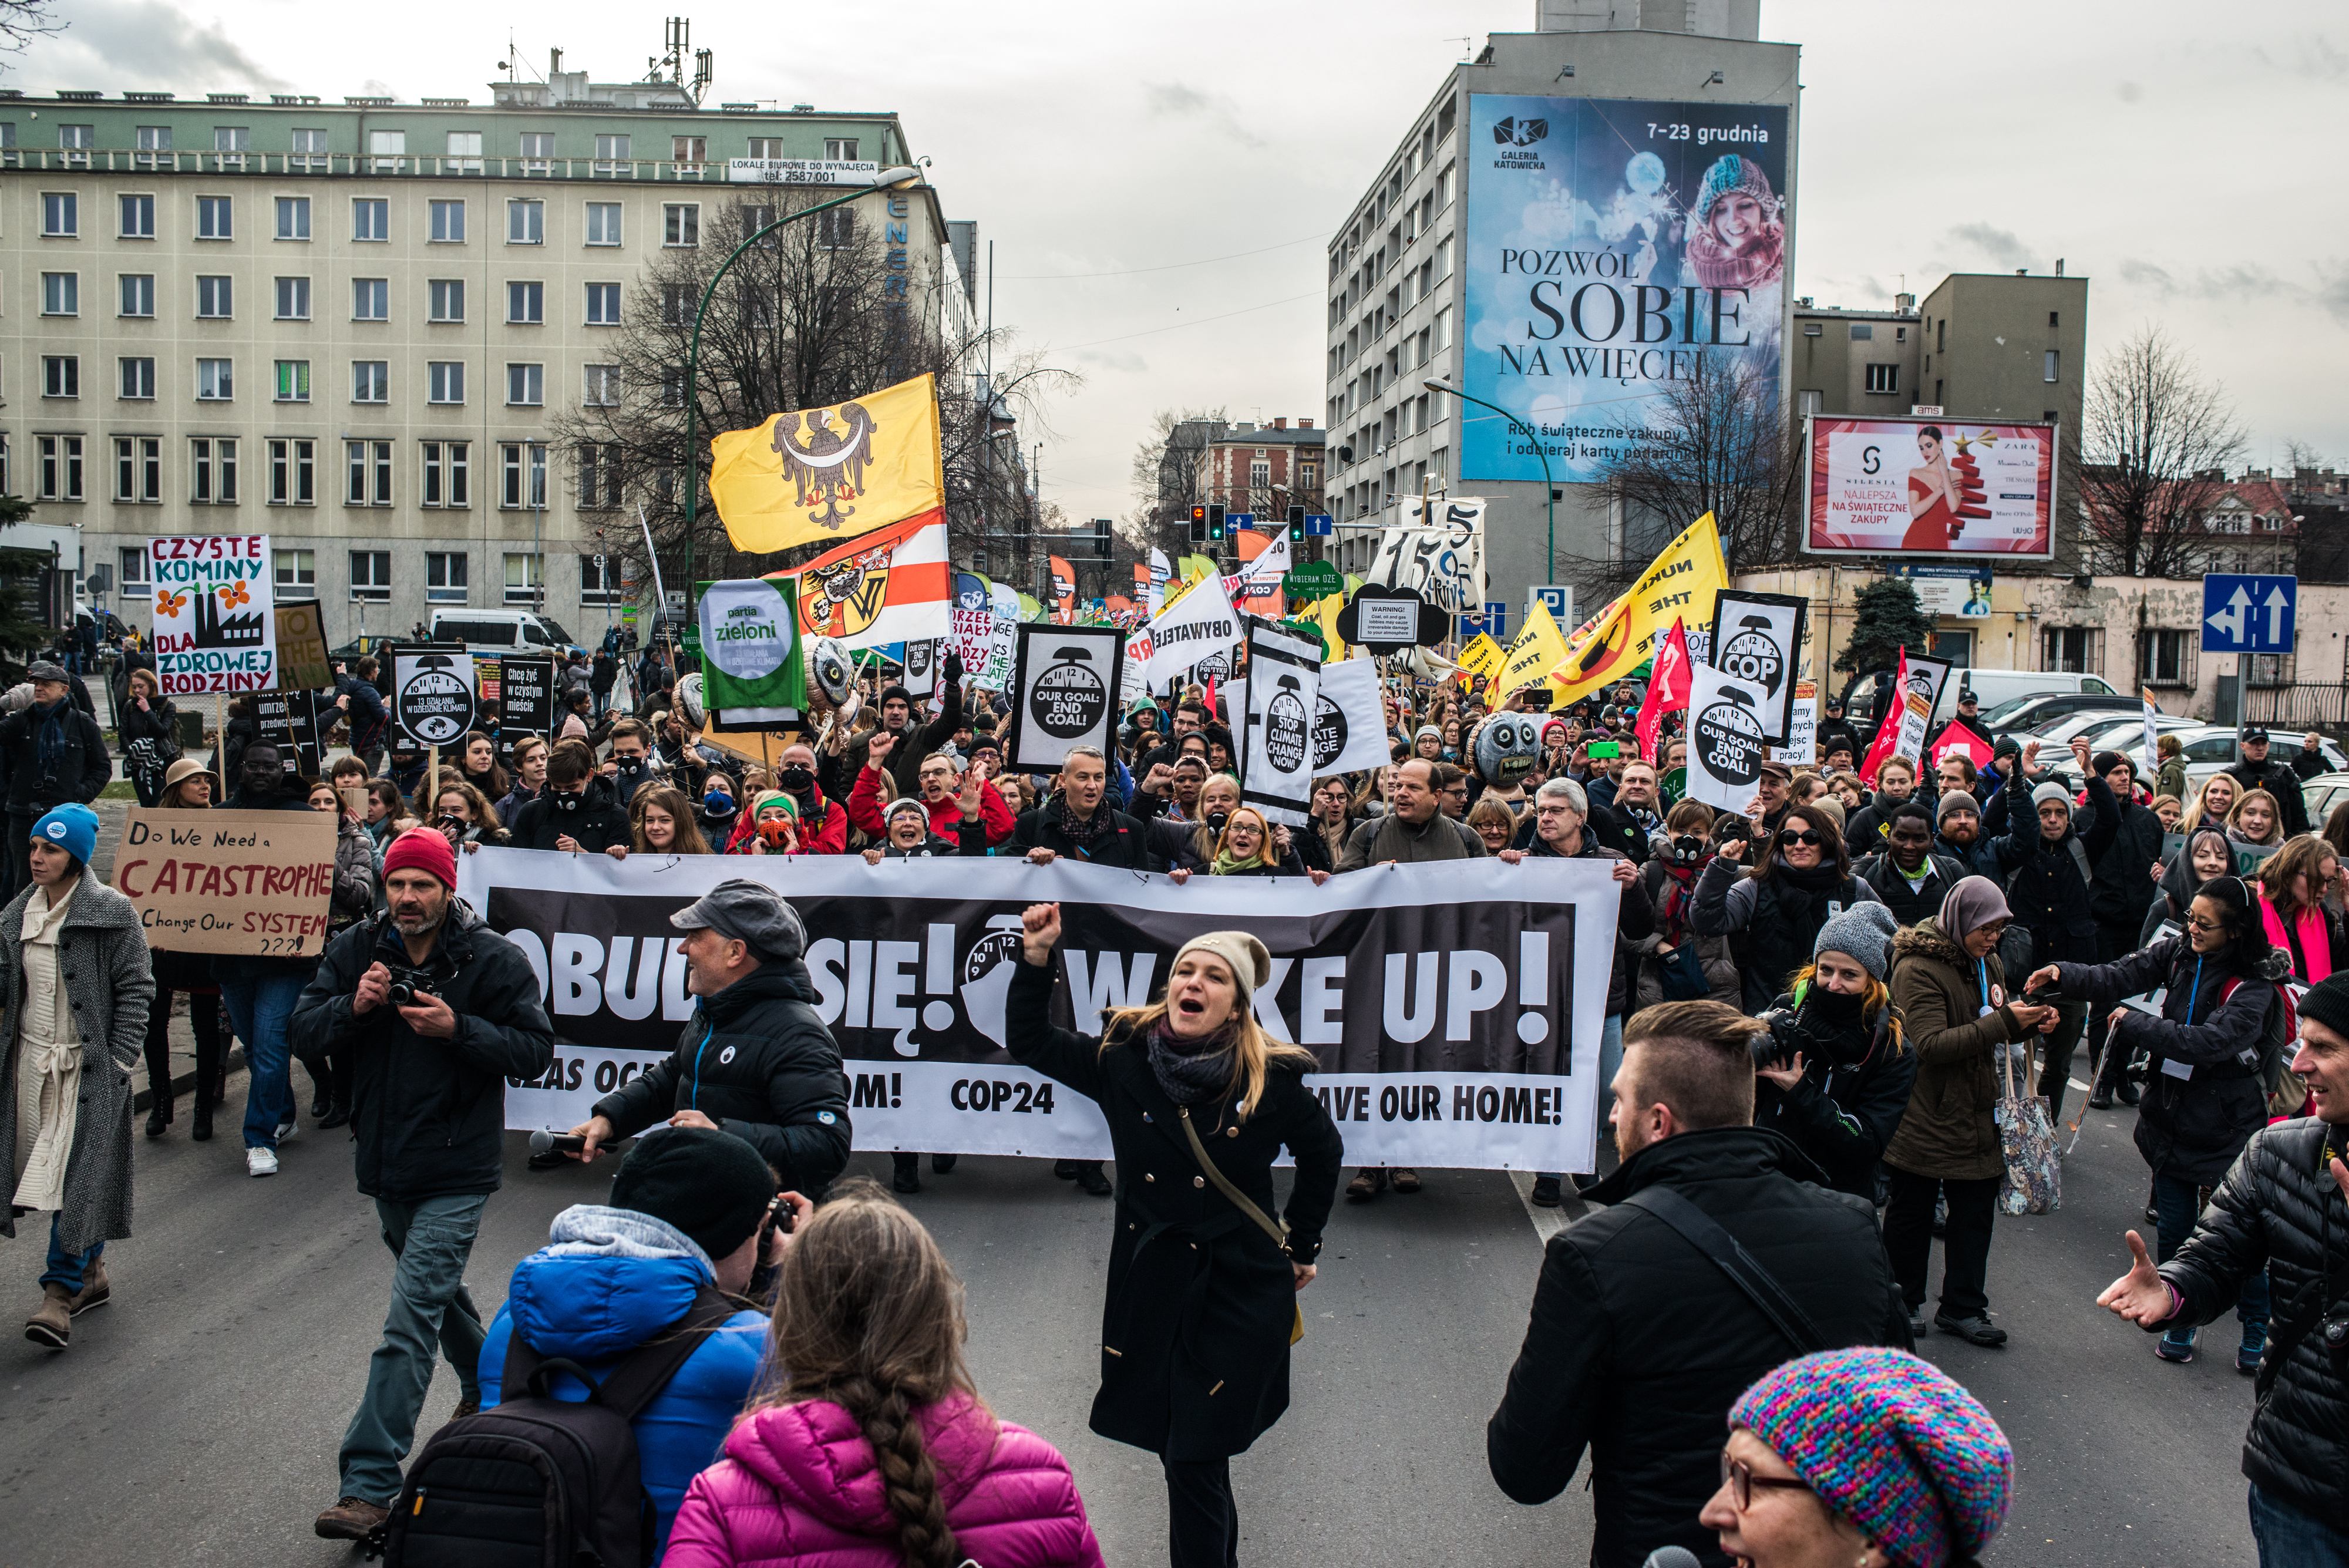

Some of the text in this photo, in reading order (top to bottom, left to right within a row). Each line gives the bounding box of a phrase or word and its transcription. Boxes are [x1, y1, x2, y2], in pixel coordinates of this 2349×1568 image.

[1647, 123, 1768, 144] 7-23 grudnia
[1501, 151, 1539, 160] GALERIA
[732, 161, 764, 169] LOKALE
[768, 161, 806, 170] BIUROWE
[824, 162, 875, 172] WYNAJĘCIA
[1493, 160, 1546, 170] KATOWICKA
[1500, 245, 1639, 278] POZWÓL
[1527, 280, 1751, 346] SOBIE
[1497, 344, 1701, 387] NA WIĘCEJ
[1917, 406, 1940, 415] ams
[1508, 422, 1681, 443] Rób świąteczne zakupy
[1506, 441, 1618, 460] i odbieraj karty
[1844, 490, 1897, 500] NAJLEPSZA
[1832, 500, 1908, 514] NA ŚWIĄTECZNE
[1850, 514, 1890, 525] ZAKUPY
[153, 536, 261, 560] CZYSTE
[155, 559, 263, 583] KOMINY
[1290, 574, 1336, 583] WYBIERAM OZE
[1544, 592, 1559, 607] P
[728, 606, 757, 618] partia
[277, 610, 310, 637] TO
[715, 620, 776, 641] zieloni
[157, 632, 198, 654] DLA
[961, 637, 974, 646] W
[278, 638, 322, 665] THE
[914, 651, 923, 659] END
[158, 650, 272, 674] ZDROWEJ
[911, 658, 925, 668] COAL!
[1725, 654, 1777, 678] COP
[432, 675, 440, 684] 12
[508, 668, 537, 684] Chcę żyć
[1055, 671, 1062, 679] 11
[1067, 668, 1076, 677] 12
[161, 671, 272, 694] RODZINY
[1044, 677, 1053, 685] 10
[1089, 678, 1095, 687] 2
[508, 685, 543, 698] w czystym
[1036, 691, 1099, 703] OUR GOAL:
[427, 696, 455, 705] DZIAŁANIA
[507, 699, 534, 712] mieście
[1279, 700, 1283, 708] 11
[1286, 698, 1291, 706] 12
[413, 705, 442, 713] DZIEDZINIE
[443, 704, 467, 712] KLIMATU
[1053, 702, 1082, 714] END
[1273, 705, 1278, 714] 10
[1718, 709, 1725, 718] 11
[1731, 710, 1739, 720] 12
[1045, 713, 1086, 726] COAL!
[1278, 716, 1298, 731] STOP
[1709, 712, 1717, 721] 10
[1908, 715, 1924, 733] Czujesz
[1270, 728, 1302, 747] CLIMATE
[1701, 724, 1761, 755] OUR GOAL:
[1905, 730, 1920, 747] klimat?
[1267, 744, 1303, 761] CHANGE
[1716, 741, 1745, 760] END
[1779, 749, 1805, 762] pracy!
[1902, 745, 1913, 761] Walcz
[1273, 755, 1295, 769] NOW!
[1708, 751, 1749, 776] COAL!
[129, 822, 270, 847] Do We Need a
[120, 859, 334, 898] CATASTROPHE
[142, 909, 328, 937] Change Our SYSTEM
[984, 943, 992, 952] 11
[1002, 937, 1015, 947] 12
[973, 953, 986, 963] 10
[971, 966, 980, 976] 9
[804, 923, 954, 1056] SIĘ!
[1384, 931, 1549, 1045] UP!
[950, 1079, 1054, 1114] COP24
[1380, 1085, 1562, 1126] OUR HOME!
